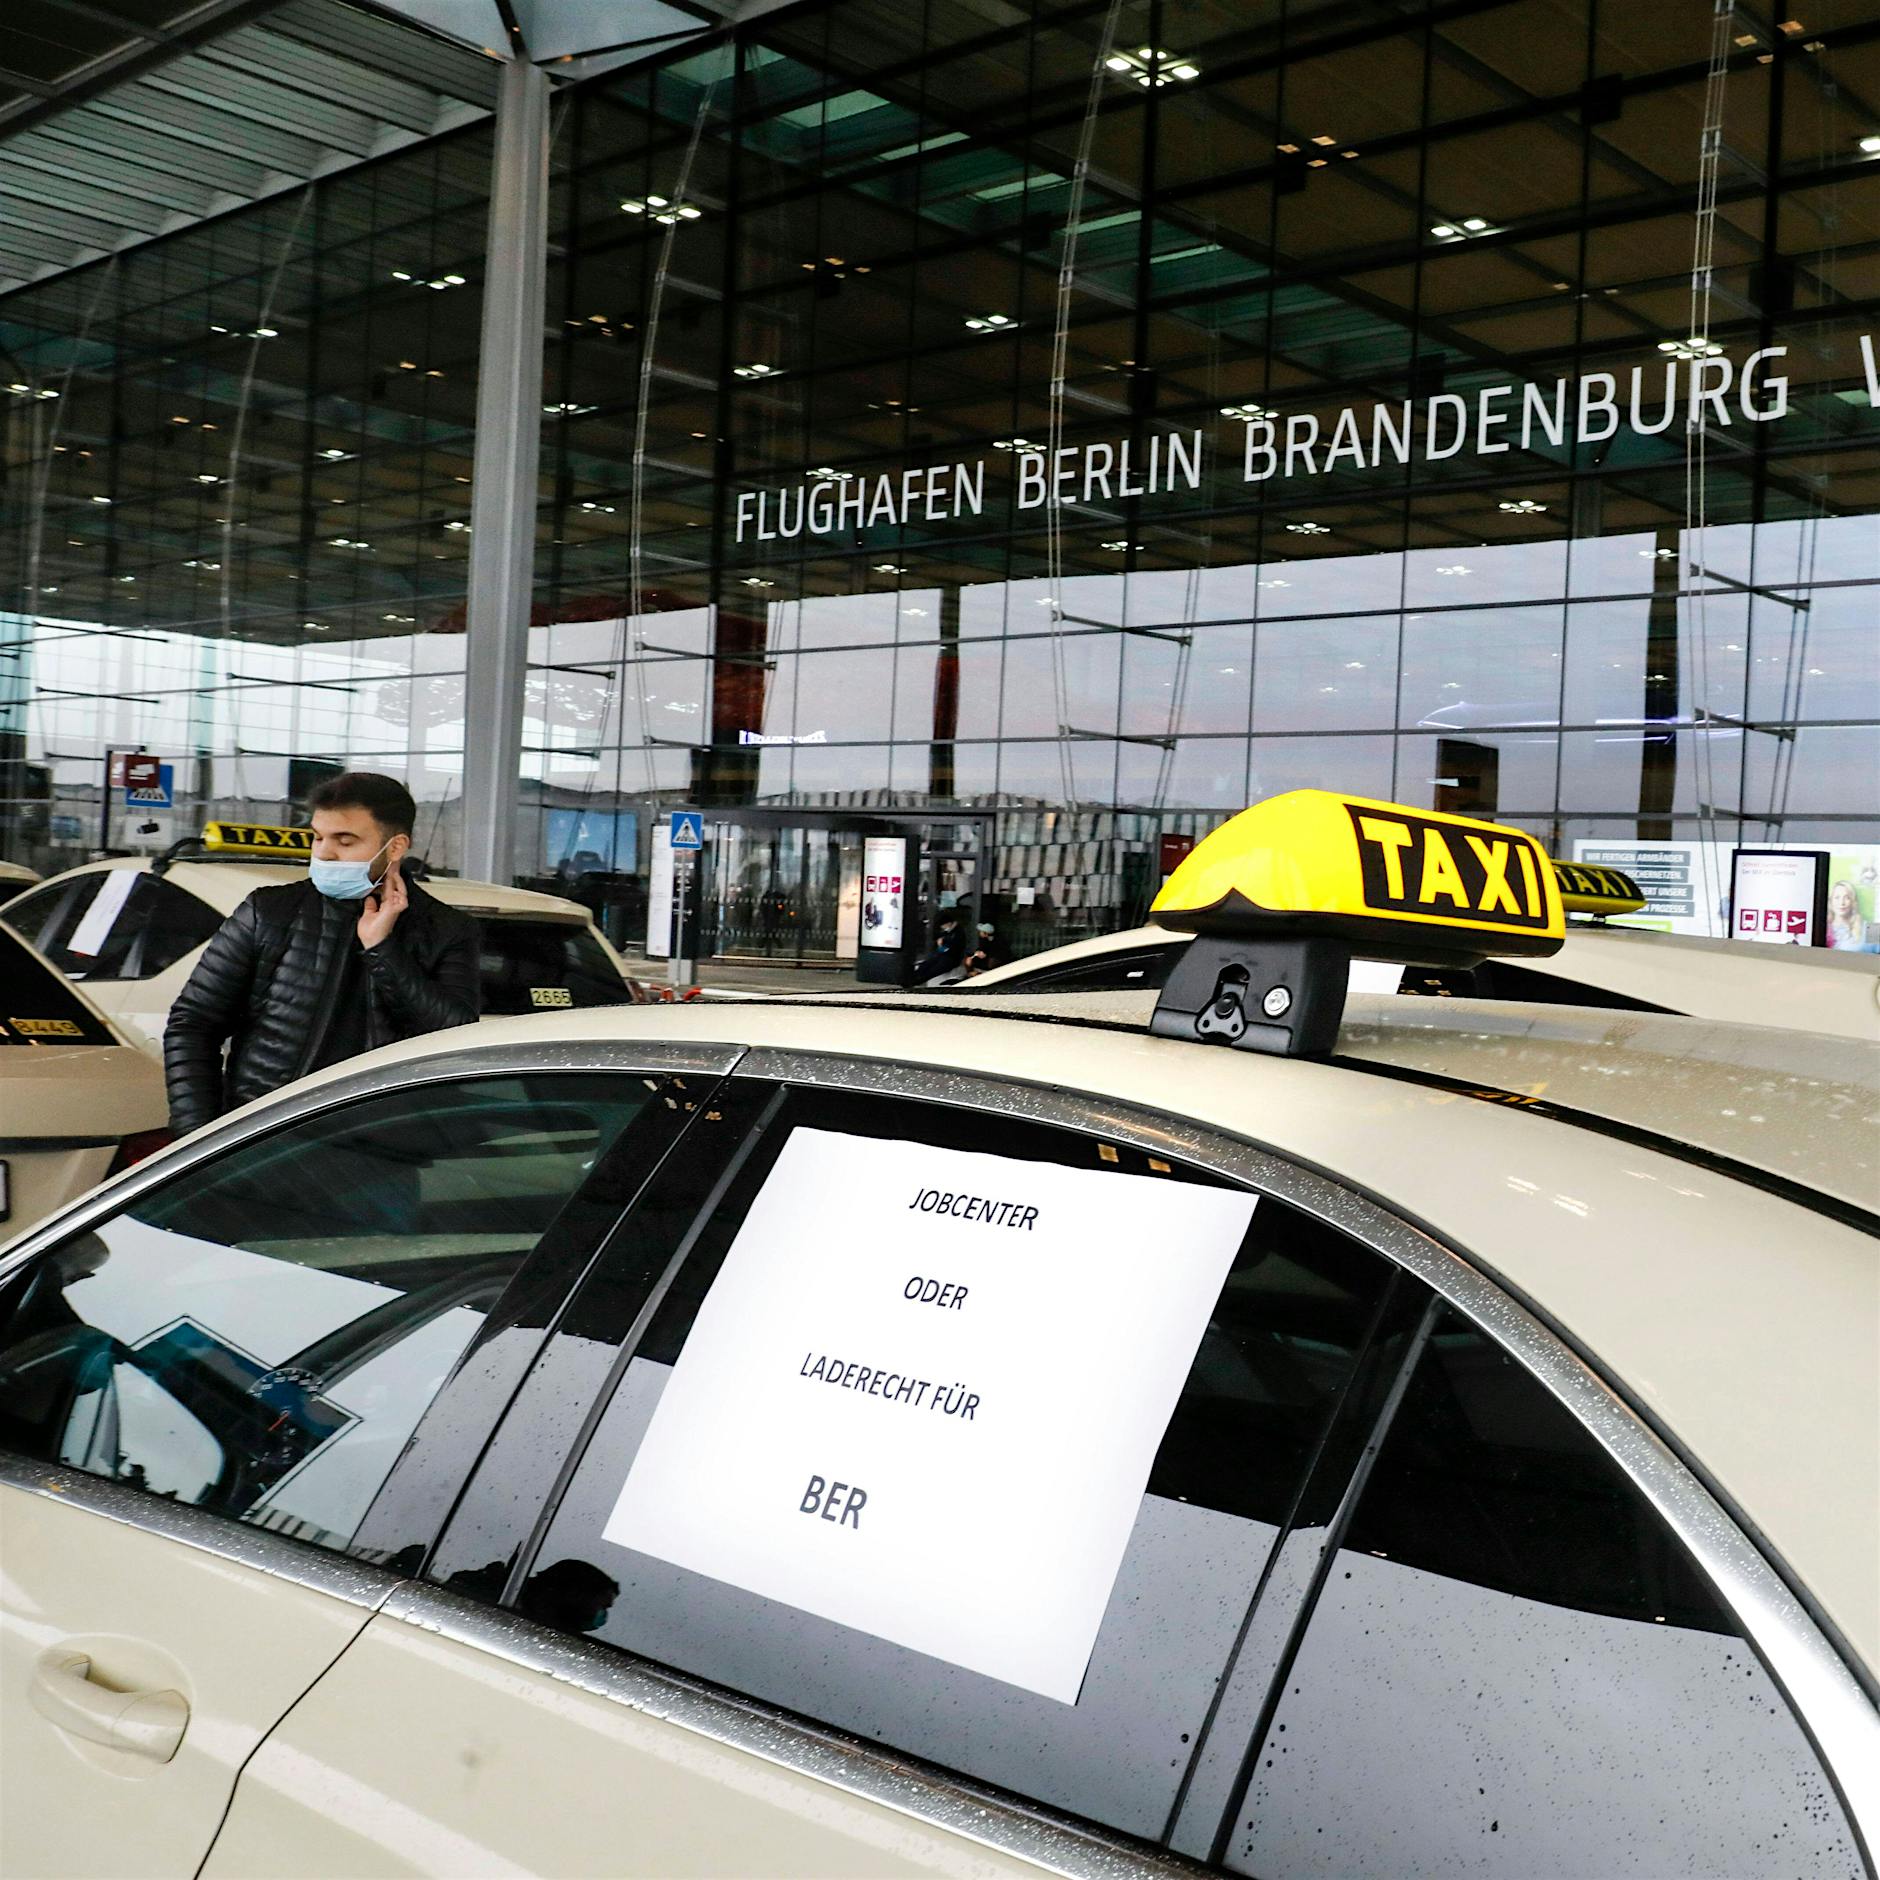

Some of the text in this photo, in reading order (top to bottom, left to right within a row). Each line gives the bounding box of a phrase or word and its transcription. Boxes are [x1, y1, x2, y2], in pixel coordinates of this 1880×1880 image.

[736, 460, 984, 543] FLUGHAFEN
[1018, 429, 1202, 509] BERLIN
[1243, 346, 1789, 483] BRANDENBURG
[230, 827, 311, 848] TAXI
[1359, 816, 1541, 918] TAXI
[533, 990, 571, 1003] 2665
[909, 1188, 1039, 1231] JOBCENTER
[903, 1276, 968, 1310] ODER
[800, 1352, 981, 1421] LADERECHT FÜR
[800, 1474, 867, 1530] BER
